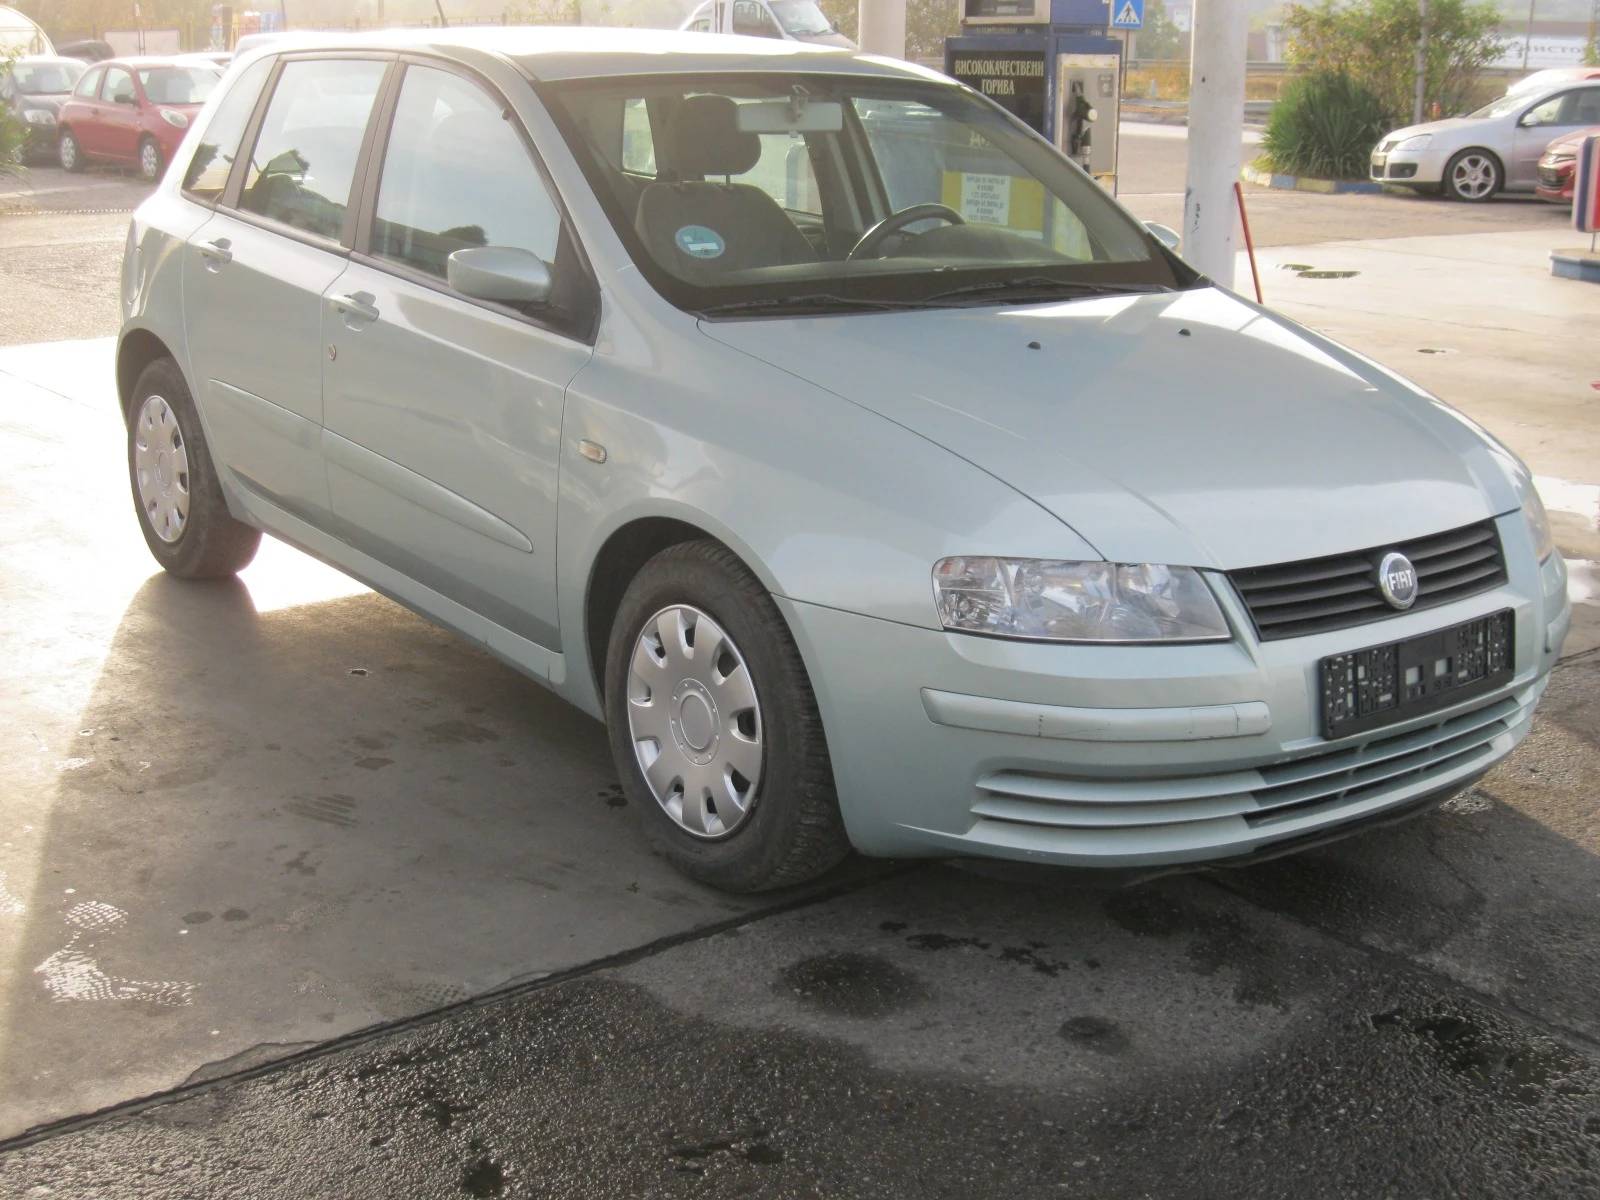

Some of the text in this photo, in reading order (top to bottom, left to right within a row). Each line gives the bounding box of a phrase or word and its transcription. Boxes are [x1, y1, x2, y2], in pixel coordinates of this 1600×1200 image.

[955, 60, 1044, 77] ВИСОКОКАЧЕСТВЕНИ
[981, 79, 1015, 95] ГОРИВА
[1388, 569, 1412, 590] FIAT
